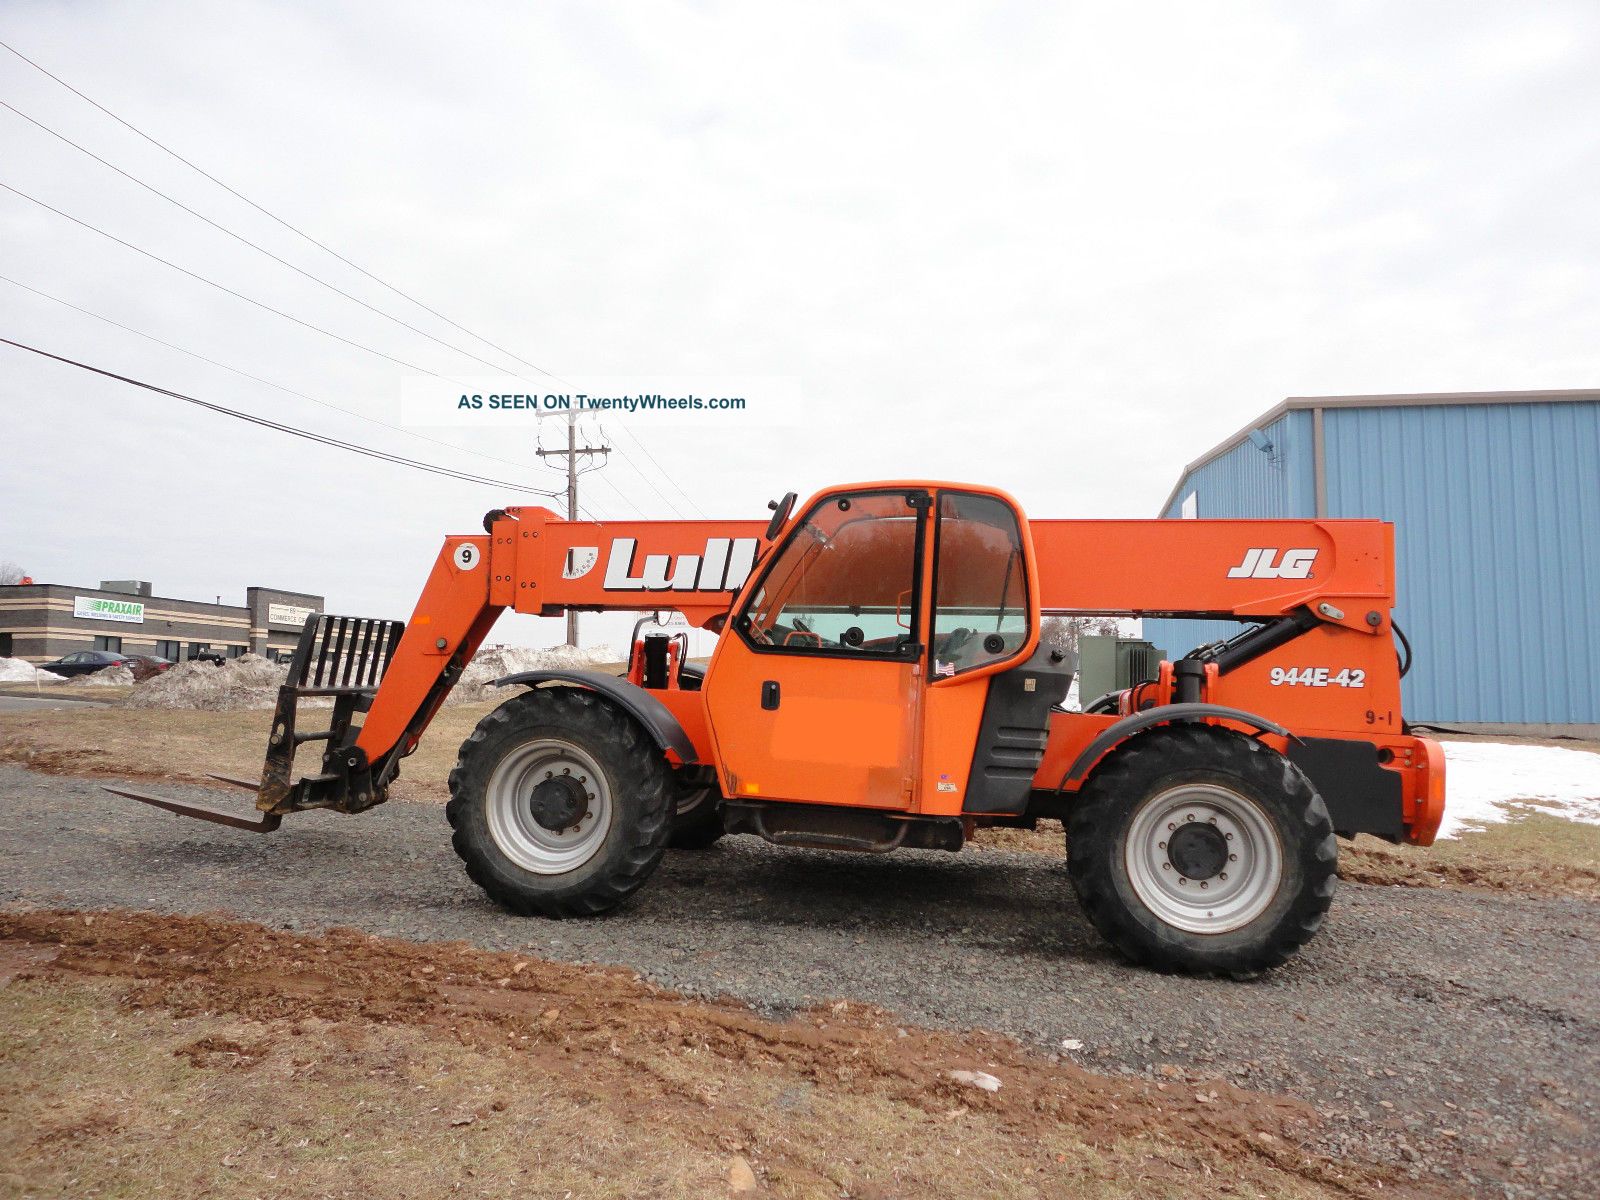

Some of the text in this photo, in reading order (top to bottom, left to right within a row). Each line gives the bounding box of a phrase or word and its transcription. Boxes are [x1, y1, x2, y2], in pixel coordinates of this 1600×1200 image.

[462, 549, 472, 563] 9
[603, 538, 761, 592] Lull
[1226, 548, 1319, 579] JLG
[102, 601, 142, 616] PRAXAIR
[270, 614, 297, 622] COMMERCE
[1270, 667, 1366, 688] 944E-42
